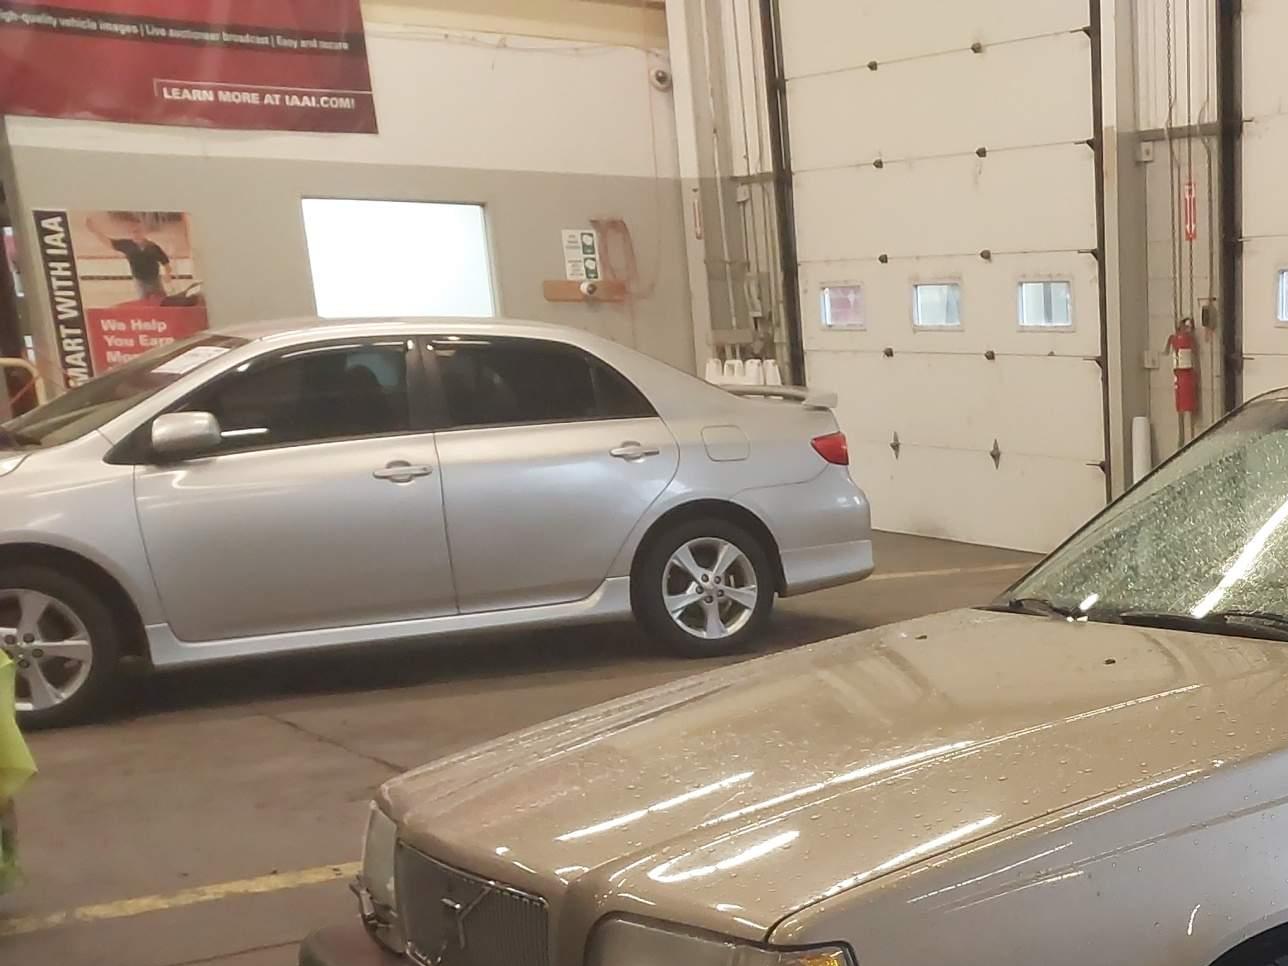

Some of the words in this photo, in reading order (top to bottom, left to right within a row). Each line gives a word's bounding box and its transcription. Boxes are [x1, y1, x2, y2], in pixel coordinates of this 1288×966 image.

[58, 17, 97, 31] vehicle
[146, 24, 167, 37] Live
[222, 32, 269, 44] broadcast
[276, 35, 297, 49] Easy
[300, 38, 318, 48] and
[163, 87, 214, 102] LEARN
[218, 90, 260, 105] MORE
[264, 93, 282, 105] AT
[40, 216, 68, 255] IAA
[48, 261, 81, 321] WITH
[101, 319, 127, 331] We
[130, 319, 168, 333] Help
[103, 335, 135, 347] You
